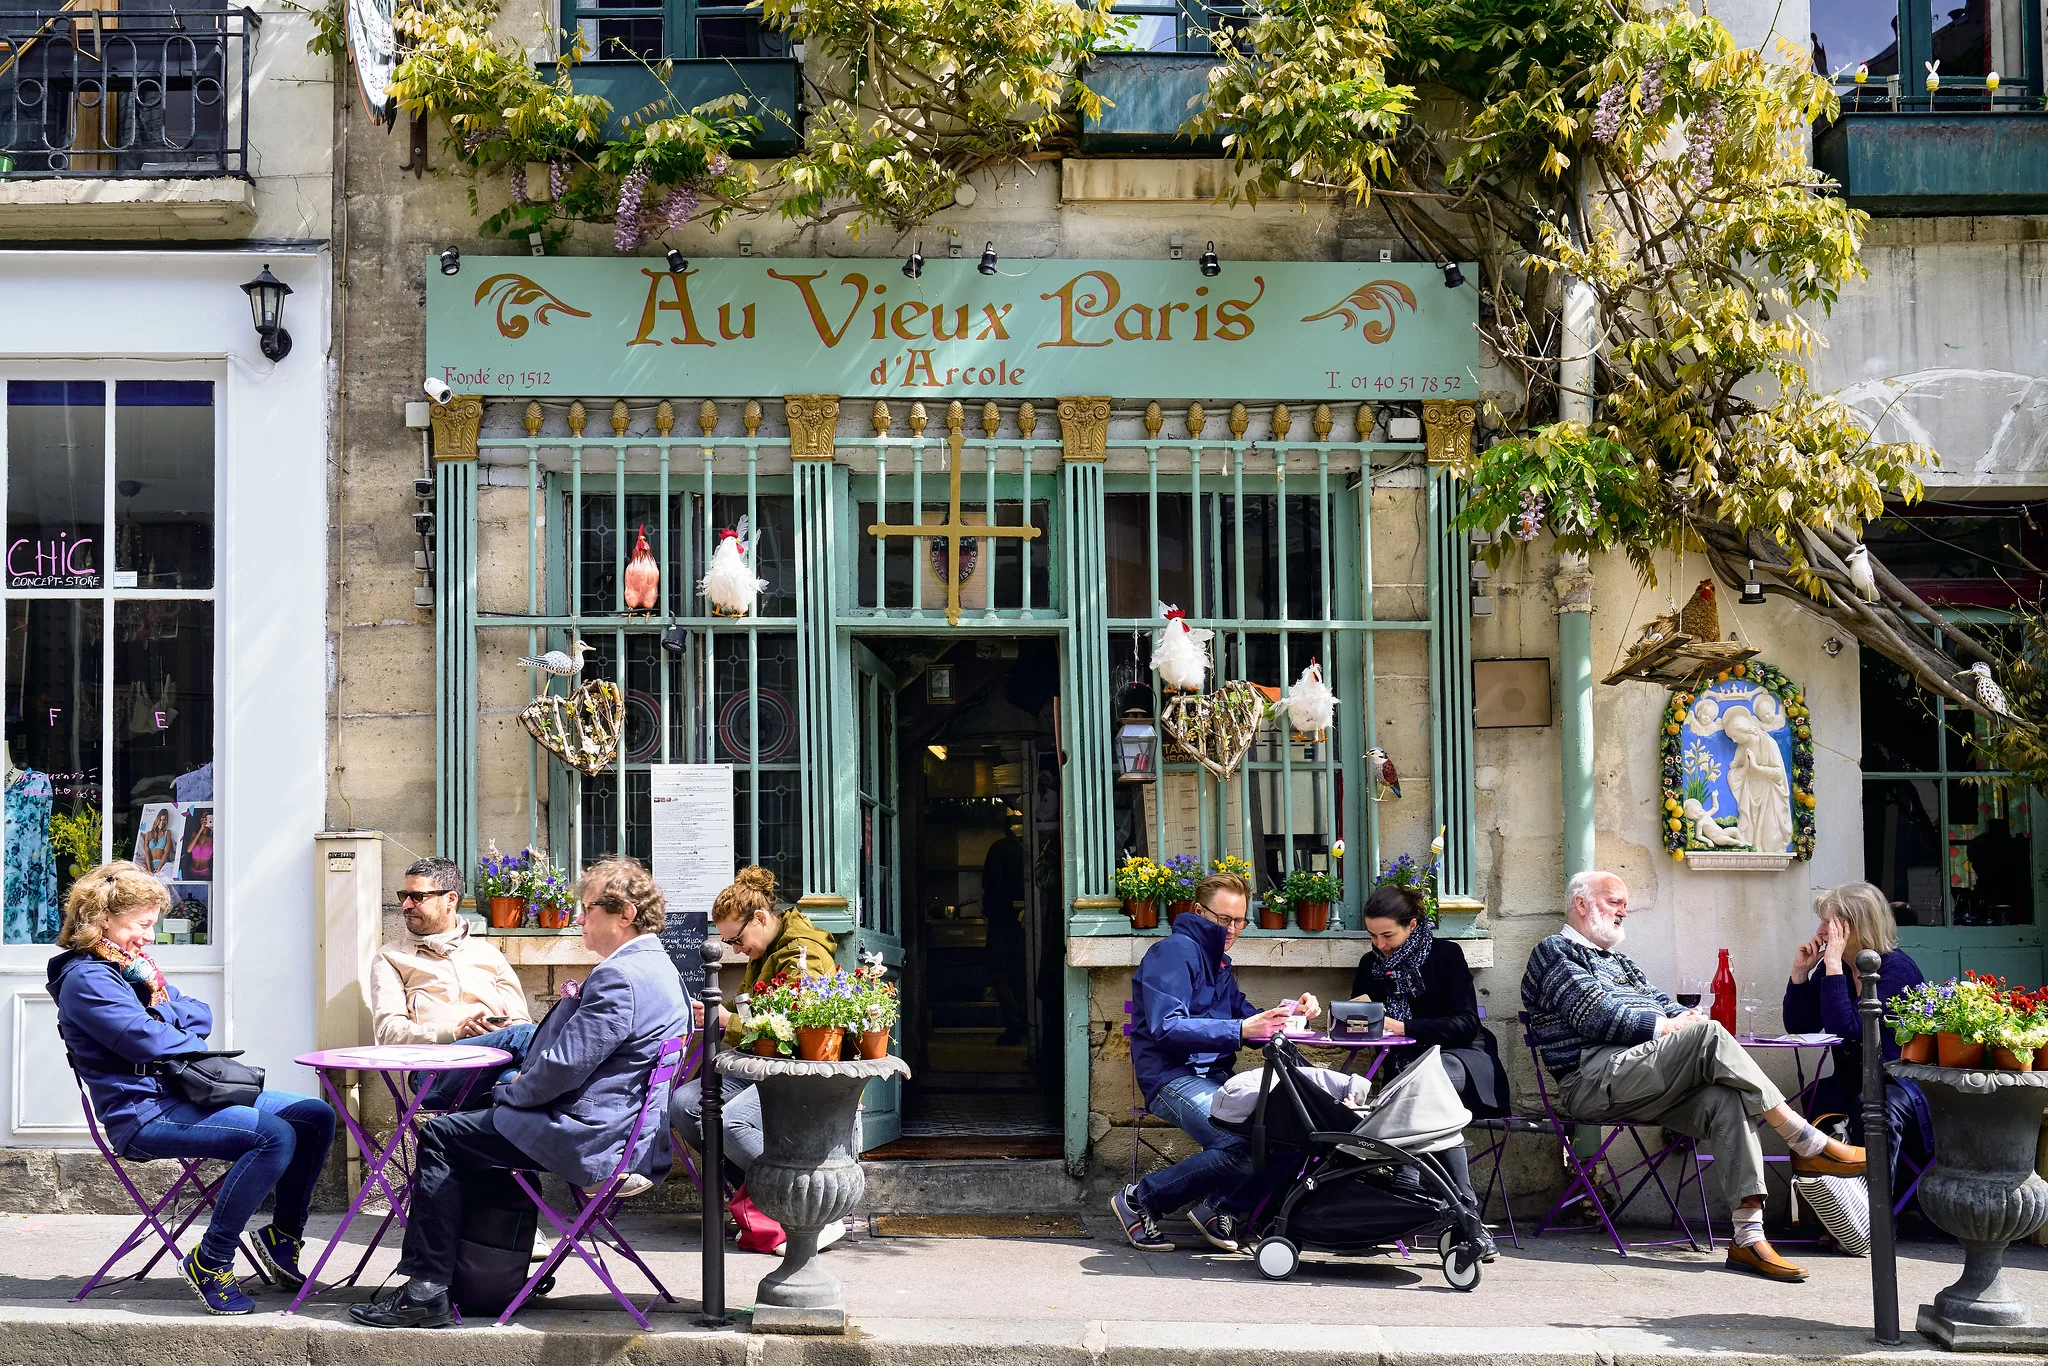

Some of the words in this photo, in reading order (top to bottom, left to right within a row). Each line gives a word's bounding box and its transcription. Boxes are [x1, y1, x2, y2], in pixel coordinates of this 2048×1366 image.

[626, 268, 756, 347] Au
[767, 268, 1012, 349] Vieux
[1037, 270, 1265, 349] Paris
[441, 365, 491, 391] Fondé
[497, 373, 515, 391] en
[520, 371, 551, 388] 1512
[870, 347, 1025, 387] d'Arcole
[1351, 376, 1367, 389] 01
[1374, 376, 1394, 392] 40
[1398, 376, 1414, 392] 51
[1421, 376, 1438, 392] 78
[1443, 376, 1461, 393] 52
